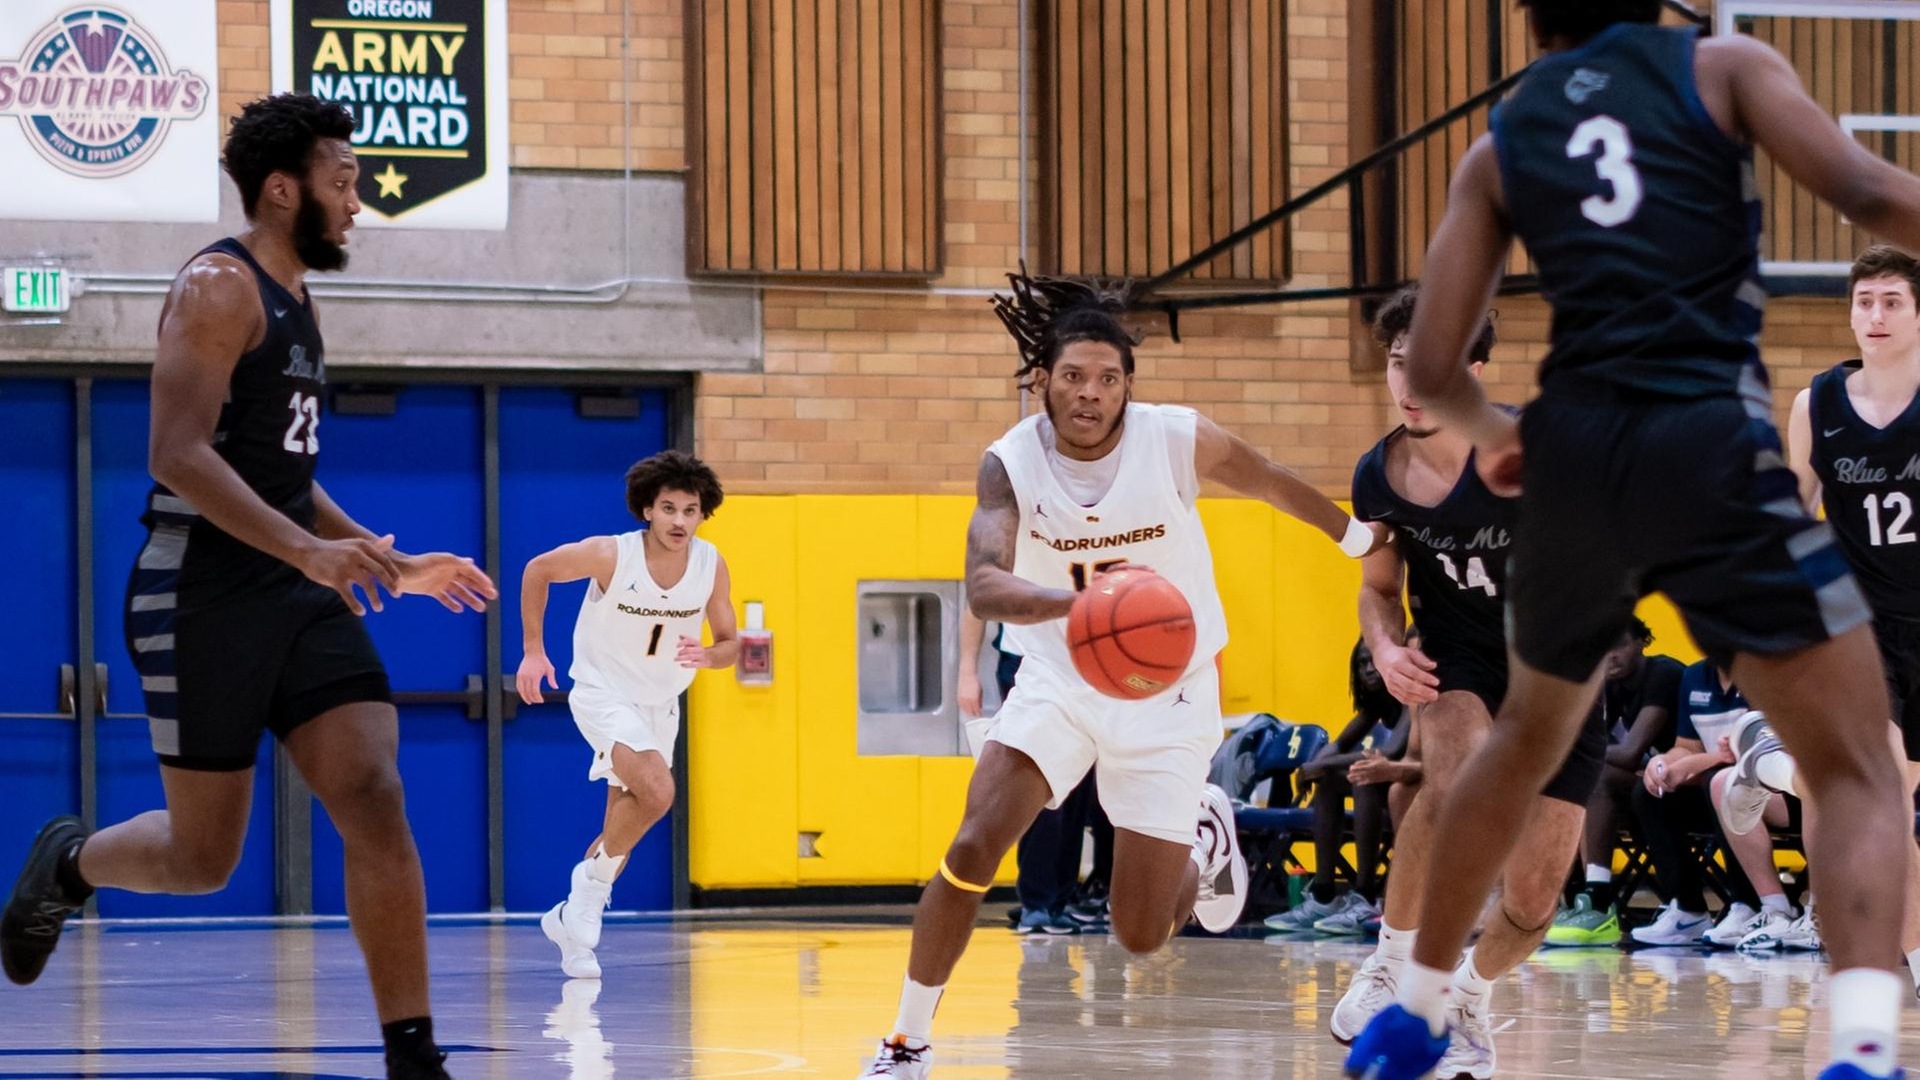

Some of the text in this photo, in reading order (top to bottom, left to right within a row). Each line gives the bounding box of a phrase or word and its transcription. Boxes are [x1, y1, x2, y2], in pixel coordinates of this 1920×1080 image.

[347, 0, 432, 18] OREGON
[312, 31, 465, 75] ARMY
[0, 66, 201, 110] SOUTHPAW'S
[311, 74, 467, 105] NATIONAL
[344, 105, 469, 147] UARD
[1565, 114, 1643, 228] 3
[16, 271, 60, 306] EXIT
[283, 391, 320, 455] 23
[1834, 453, 1920, 484] Blue M
[1030, 523, 1166, 552] ROADRUNNERS
[1862, 491, 1917, 546] 12
[1436, 552, 1497, 597] 14
[646, 623, 664, 656] 1
